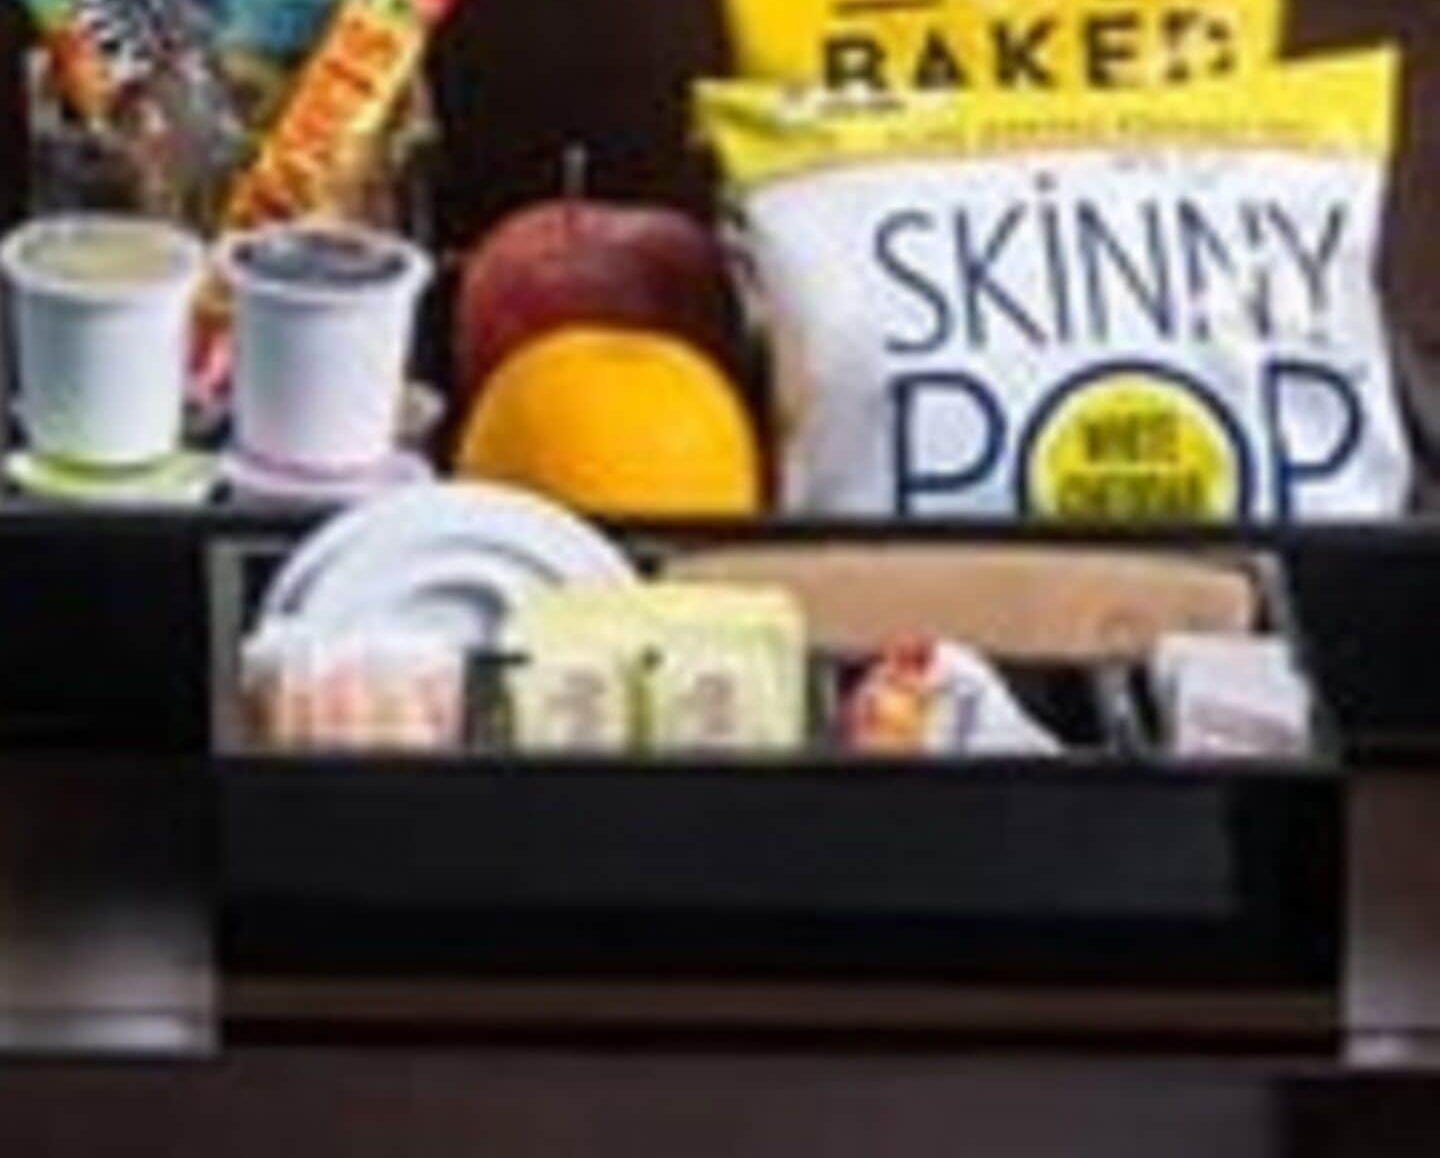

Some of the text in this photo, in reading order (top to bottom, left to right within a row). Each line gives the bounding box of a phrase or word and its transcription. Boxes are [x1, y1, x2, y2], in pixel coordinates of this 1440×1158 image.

[822, 7, 1239, 94] BAKED
[872, 170, 1347, 356] SKINNY
[890, 356, 1364, 518] POP
